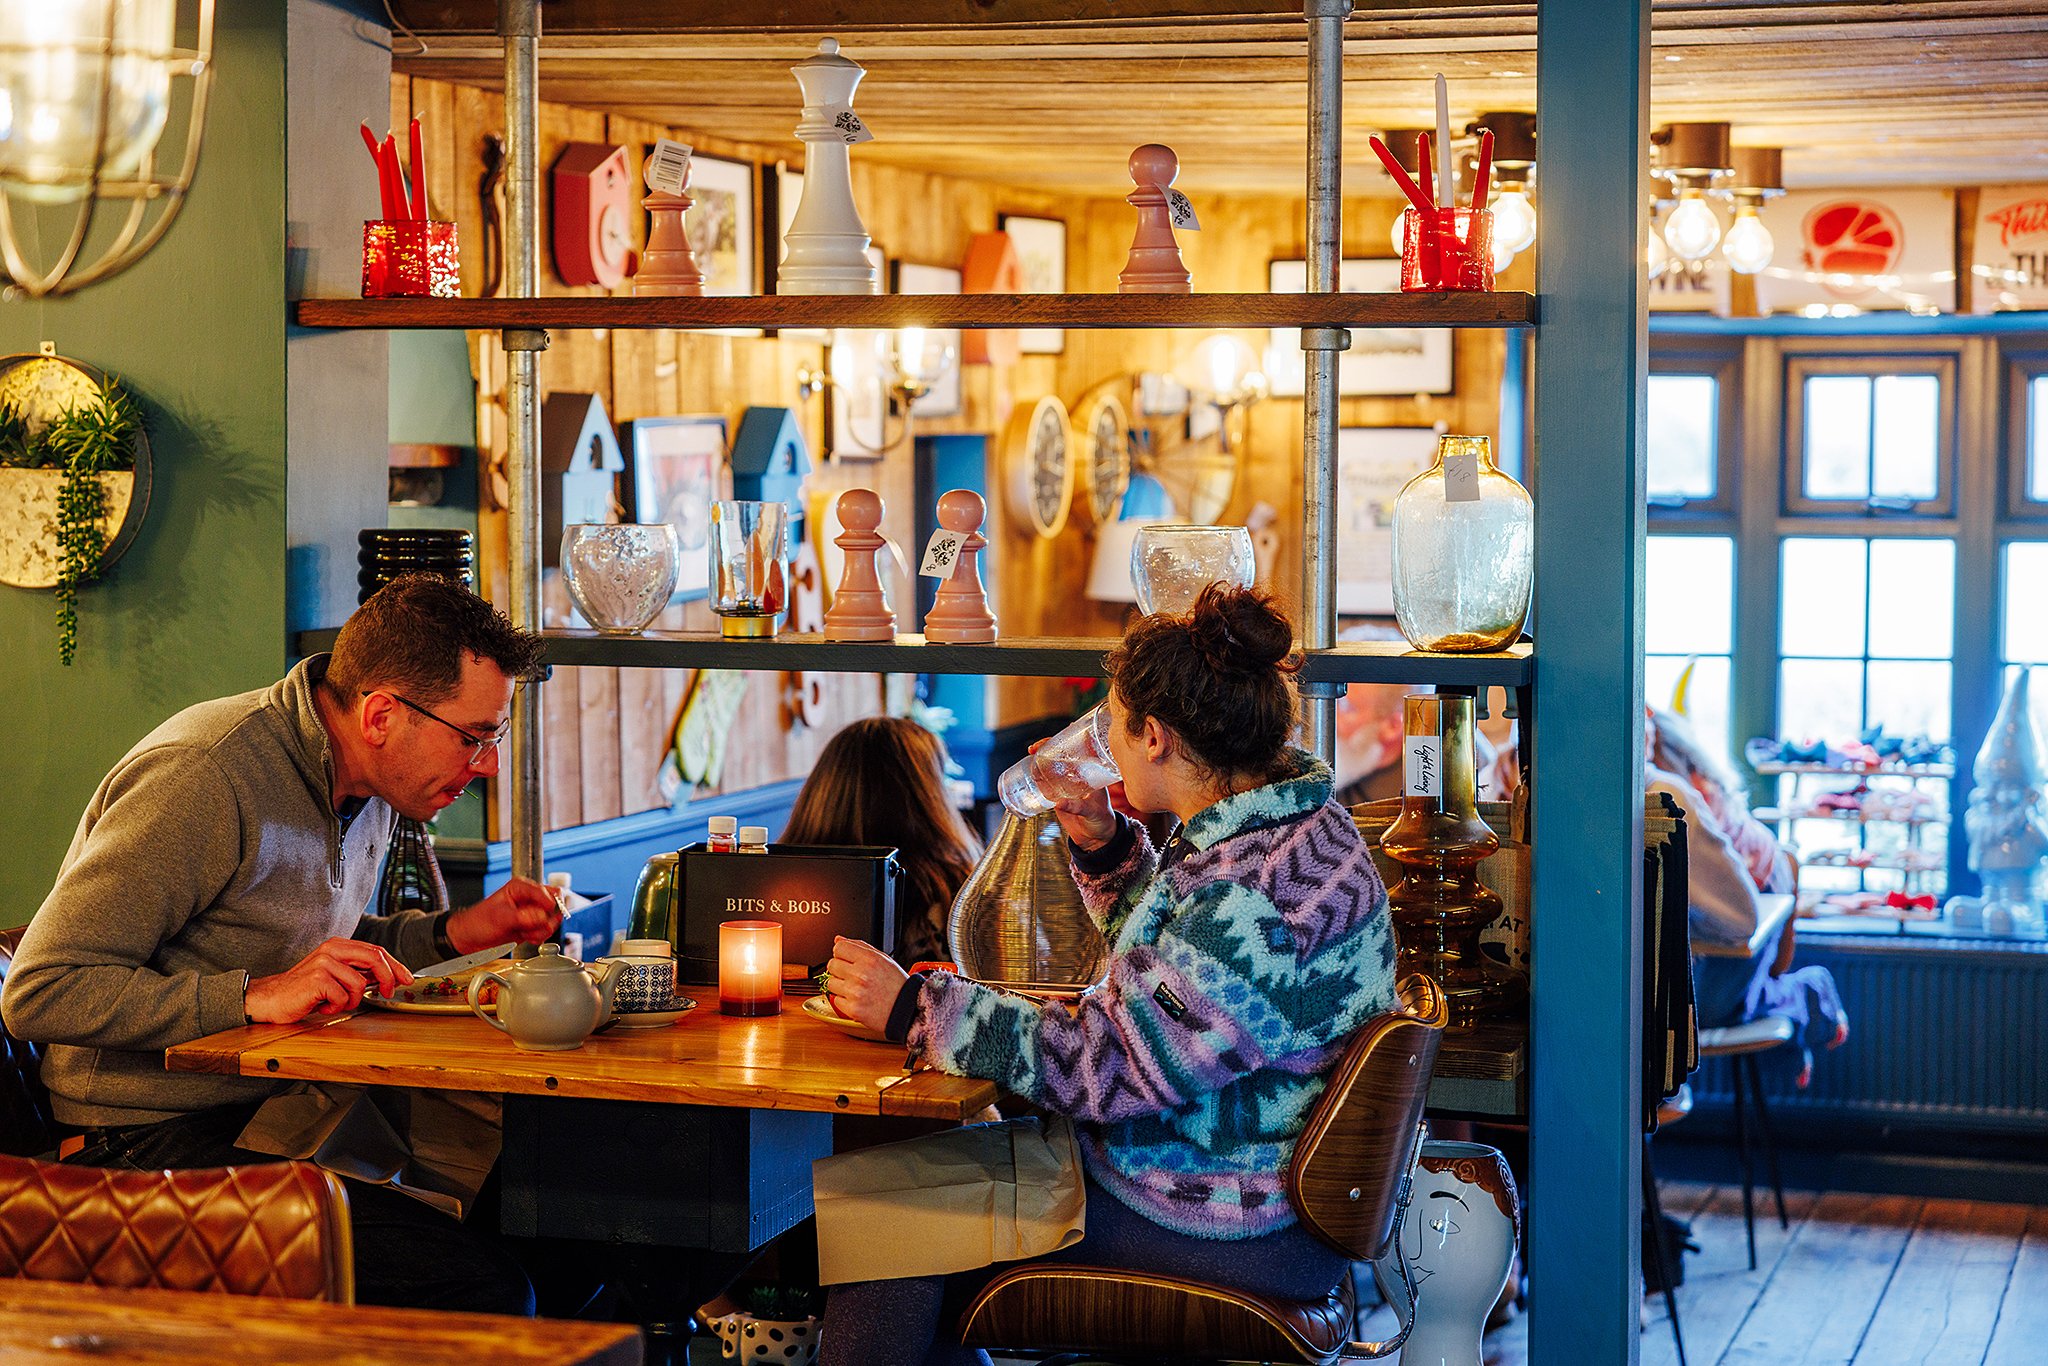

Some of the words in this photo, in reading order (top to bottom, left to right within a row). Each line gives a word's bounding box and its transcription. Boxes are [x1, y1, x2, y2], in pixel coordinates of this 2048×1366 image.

[1414, 770, 1436, 794] Living
[725, 897, 765, 913] BITS
[769, 899, 783, 913] &
[787, 899, 831, 915] BOBS
